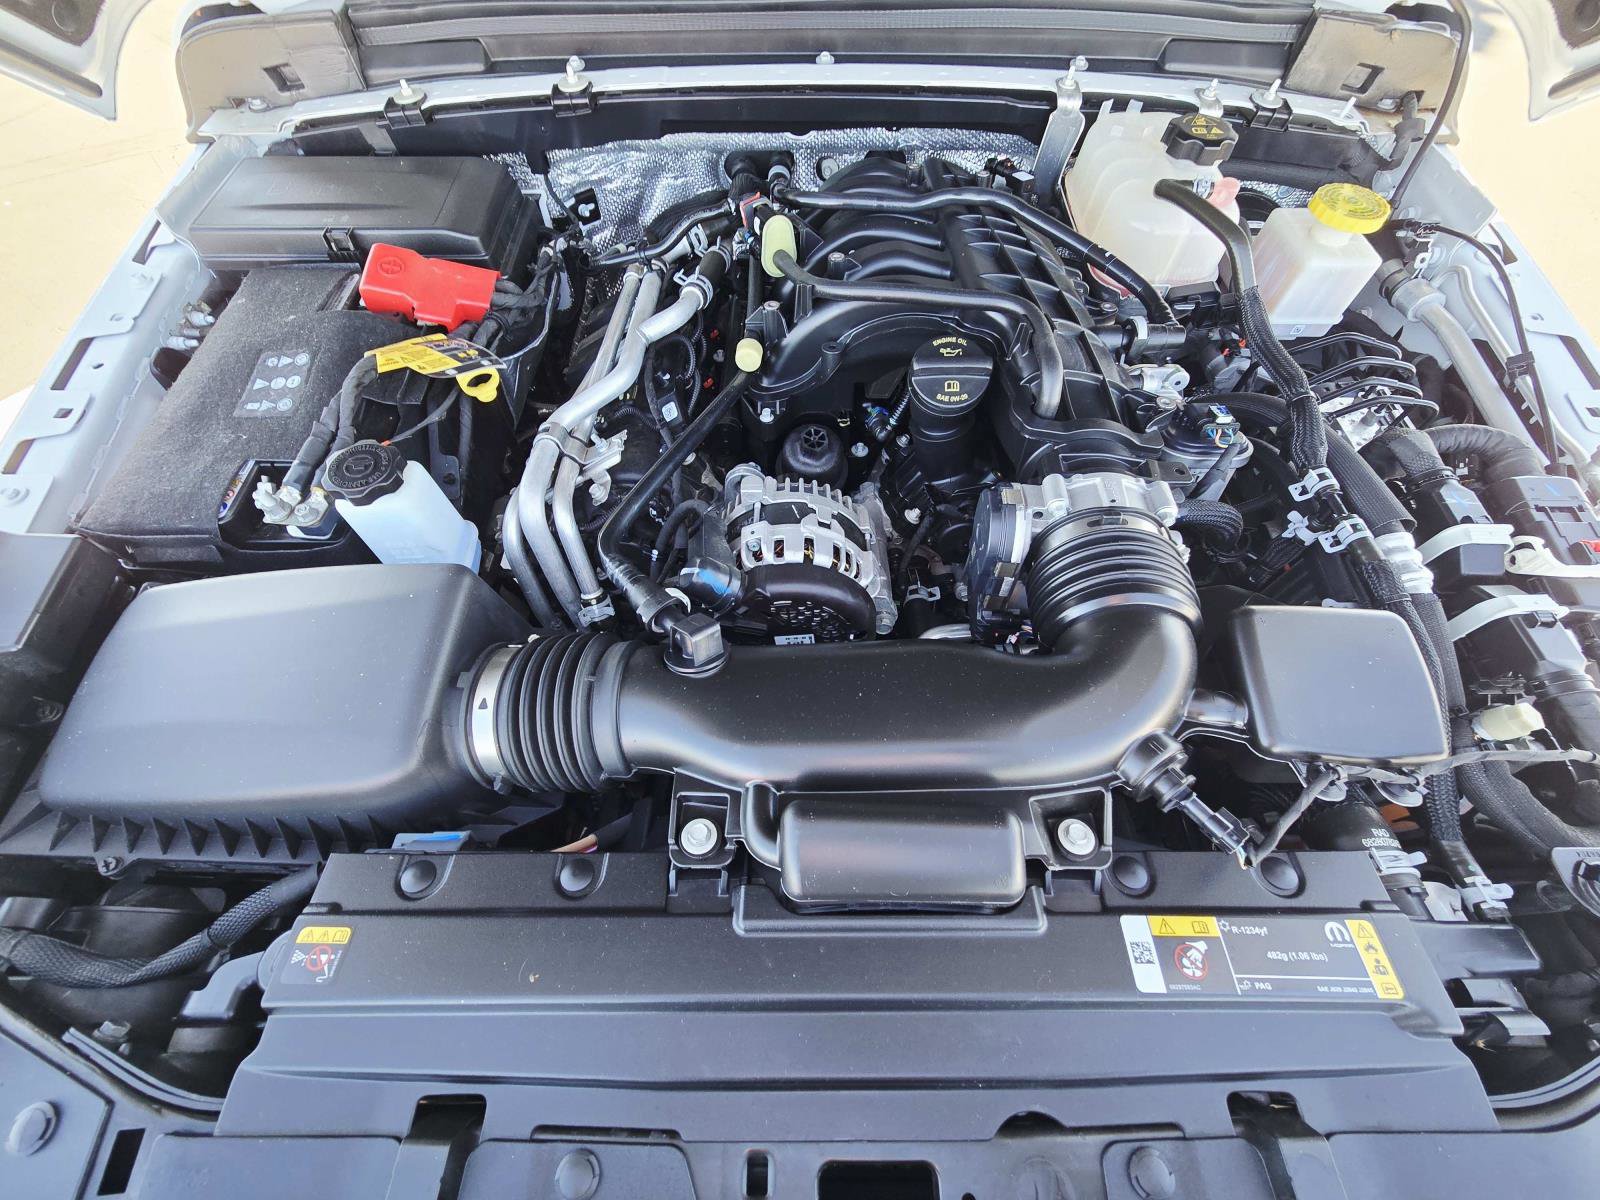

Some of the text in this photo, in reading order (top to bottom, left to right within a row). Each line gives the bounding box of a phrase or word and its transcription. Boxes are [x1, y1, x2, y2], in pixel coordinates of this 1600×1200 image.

[932, 336, 968, 346] ENGINE OIL
[936, 393, 950, 402] SAE
[1371, 828, 1390, 837] RAD
[1231, 926, 1269, 937] R-1234yf
[1266, 951, 1329, 962] 482g (1.06 lbs)
[1254, 981, 1273, 991] PAG
